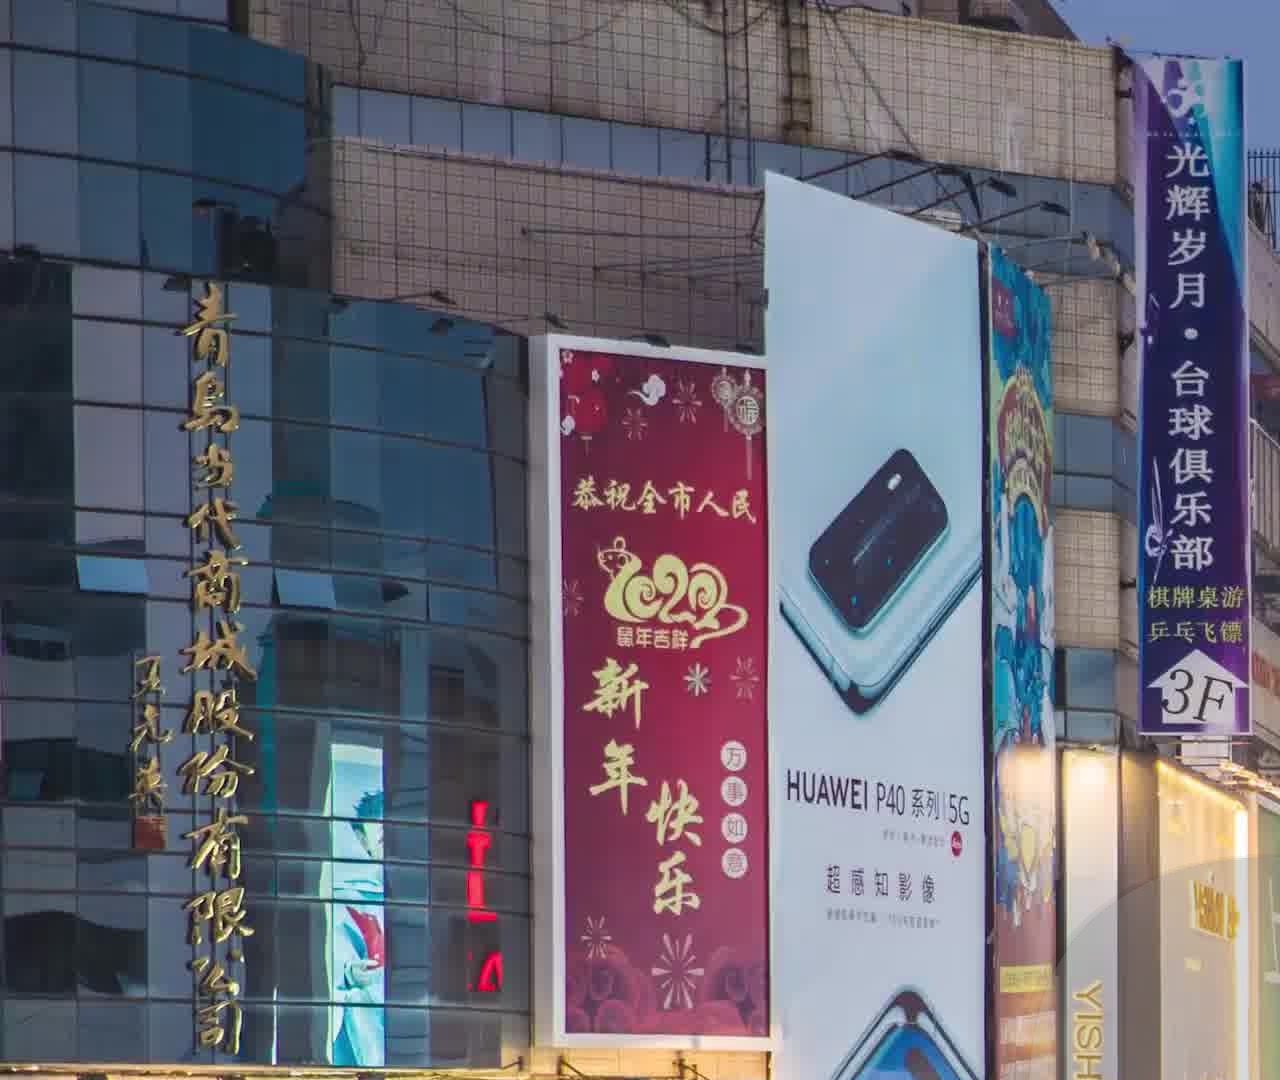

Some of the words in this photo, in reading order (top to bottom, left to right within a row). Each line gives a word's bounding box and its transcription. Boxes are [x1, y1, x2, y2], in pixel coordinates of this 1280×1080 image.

[572, 475, 757, 523] 恭祝全市人民
[1147, 585, 1246, 610] 棋牌桌游
[1147, 621, 1244, 644] 乒乓飞镖
[1161, 668, 1234, 722] 3F
[786, 769, 868, 812] HUAWEI
[876, 781, 906, 817] P40
[911, 788, 939, 820] 系列
[948, 794, 970, 826] 5G
[825, 863, 936, 905] 超感知影像
